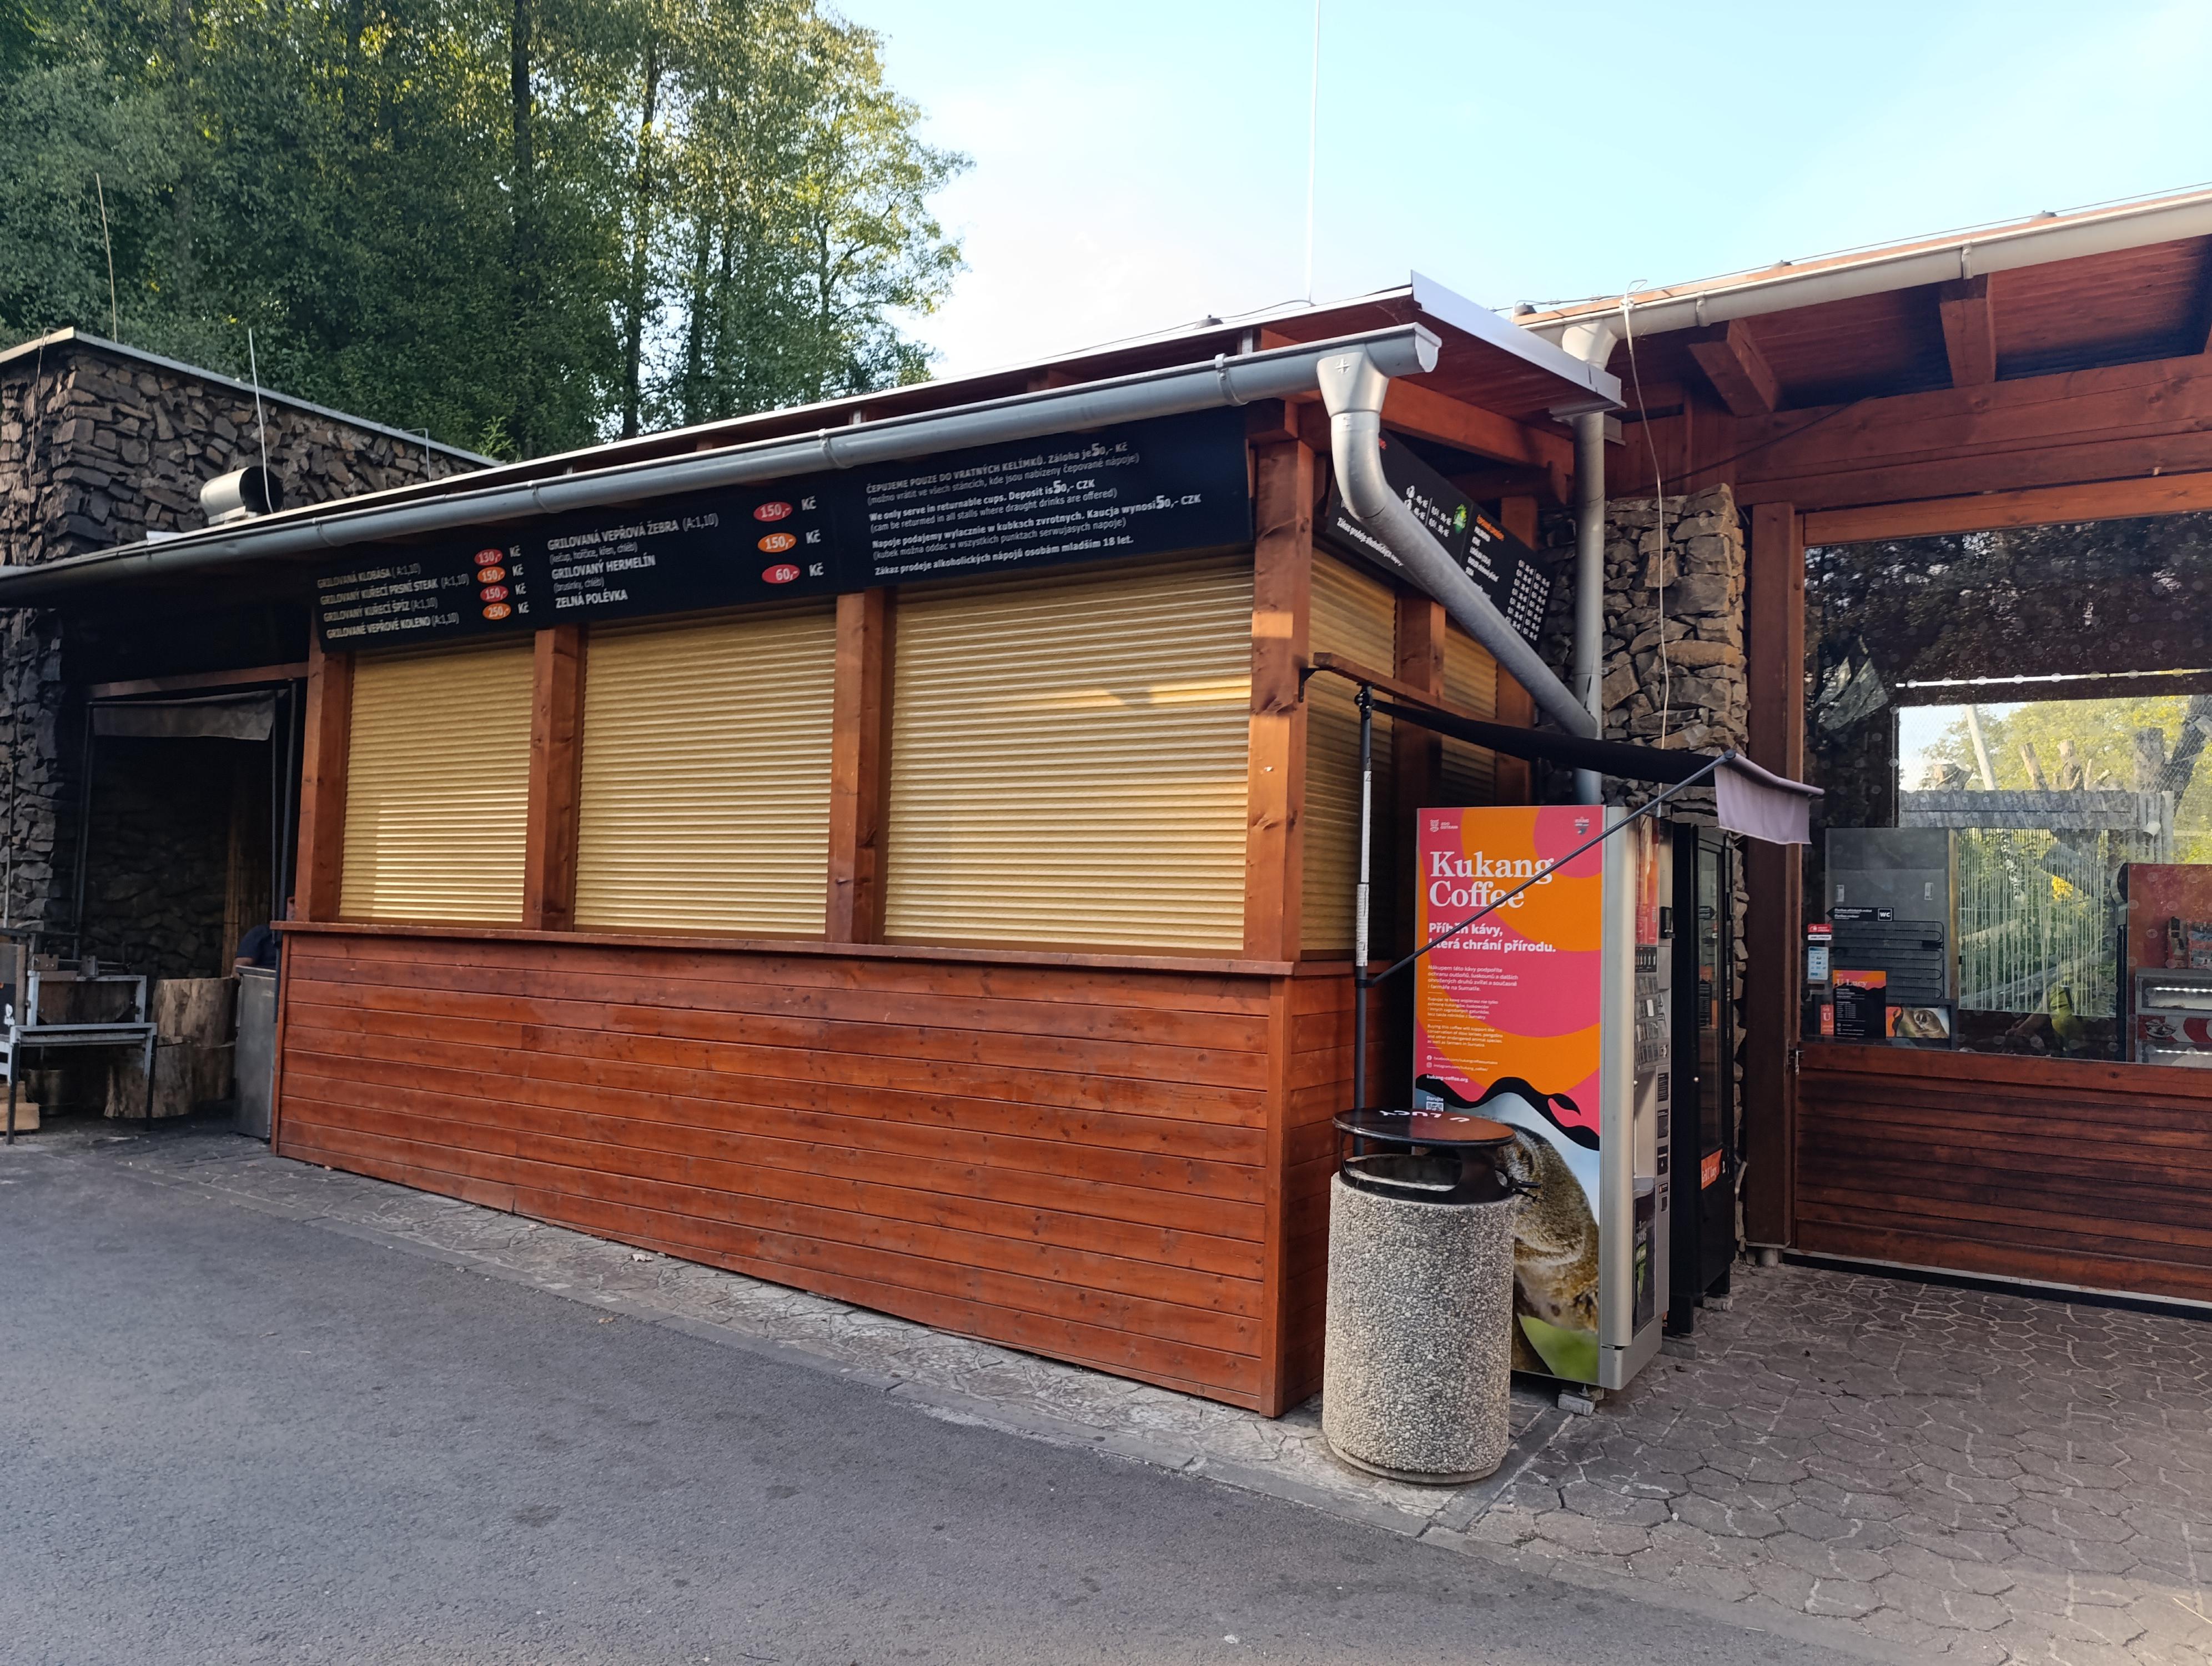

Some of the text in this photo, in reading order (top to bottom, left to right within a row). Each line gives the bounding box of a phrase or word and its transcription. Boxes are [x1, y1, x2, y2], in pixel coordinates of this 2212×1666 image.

[866, 480, 908, 493] ČEPUJEME
[910, 475, 937, 486] POUZE
[939, 473, 952, 481] DO
[953, 465, 999, 479] VRATNÝCH
[1002, 456, 1046, 471] KELÍMKŮ.
[1048, 452, 1079, 463] Záloha
[1115, 443, 1127, 452] Kč
[868, 494, 895, 506] (možno
[896, 490, 917, 500] vrátit
[929, 485, 951, 494] všech
[989, 476, 1004, 485] kde
[1006, 474, 1023, 484] jsou
[1025, 468, 1061, 479] nabízeny
[1063, 459, 1103, 473] čepované
[1105, 454, 1139, 466] nápoje)
[868, 513, 882, 521] We
[884, 510, 901, 519] only
[903, 507, 926, 516] serve
[937, 498, 982, 511] returnable
[983, 495, 1007, 504] cups.
[1009, 488, 1043, 500] Deposit
[1077, 479, 1095, 491] CZK
[901, 515, 935, 527] returned
[946, 512, 956, 521] all
[957, 509, 978, 519] stalls
[979, 506, 1004, 515] where
[1006, 500, 1038, 512] draught
[1039, 496, 1065, 507] drinks
[1083, 489, 1117, 500] offered)
[547, 530, 602, 550] GRILOVANÁ
[601, 523, 646, 541] VEPŘOVÁ
[647, 520, 679, 535] ŽEBRA
[760, 504, 790, 518] 150,-
[801, 495, 817, 510] Kč
[872, 538, 901, 548] Napoje
[903, 533, 942, 546] podajemy
[997, 519, 1034, 531] kubkach
[1087, 506, 1119, 518] Kaucja
[1181, 494, 1201, 505] CZK
[873, 548, 898, 560] (kubek
[958, 535, 999, 548] wszystkich
[1001, 530, 1037, 544] punktach
[1093, 518, 1126, 530] napoje)
[318, 571, 358, 588] GRILOVANÁ
[359, 567, 391, 581] KLOBÁSA
[479, 551, 501, 563] 130,-
[509, 545, 521, 557] Kč
[552, 529, 821, 579] GRILOVANÝ HERMELÍN 150,- Kč
[875, 535, 1133, 575] Zákaz prodeje alkoholických nápojů osobám mladším 18 let.
[320, 589, 360, 605] GRILOVANÝ
[361, 584, 389, 598] KUŘECÍ
[389, 580, 413, 594] PRSNÍ
[414, 579, 438, 591] STEAK
[482, 569, 504, 582] 150,-
[512, 564, 524, 576] Kč
[324, 605, 363, 622] GRILOVANÝ
[364, 601, 391, 615] KUŘECÍ
[485, 587, 507, 600] 150,-
[515, 583, 526, 595] Kč
[555, 562, 824, 608] ZELNÁ POLÉVKA 60,- Kč
[326, 623, 367, 639] GRILOVANÉ
[366, 618, 400, 633] VEPŘOVÉ
[400, 616, 431, 629] KOLENO
[488, 606, 509, 618] 250,-
[518, 601, 530, 614] Kč
[1430, 851, 1554, 885] Kukang
[1429, 880, 1524, 908] Coffee
[1462, 939, 1501, 950] chrání
[1504, 941, 1556, 953] přírodu.
[1471, 924, 1503, 936] kávy,
[1426, 1074, 1469, 1083] kukang-coffee.org
